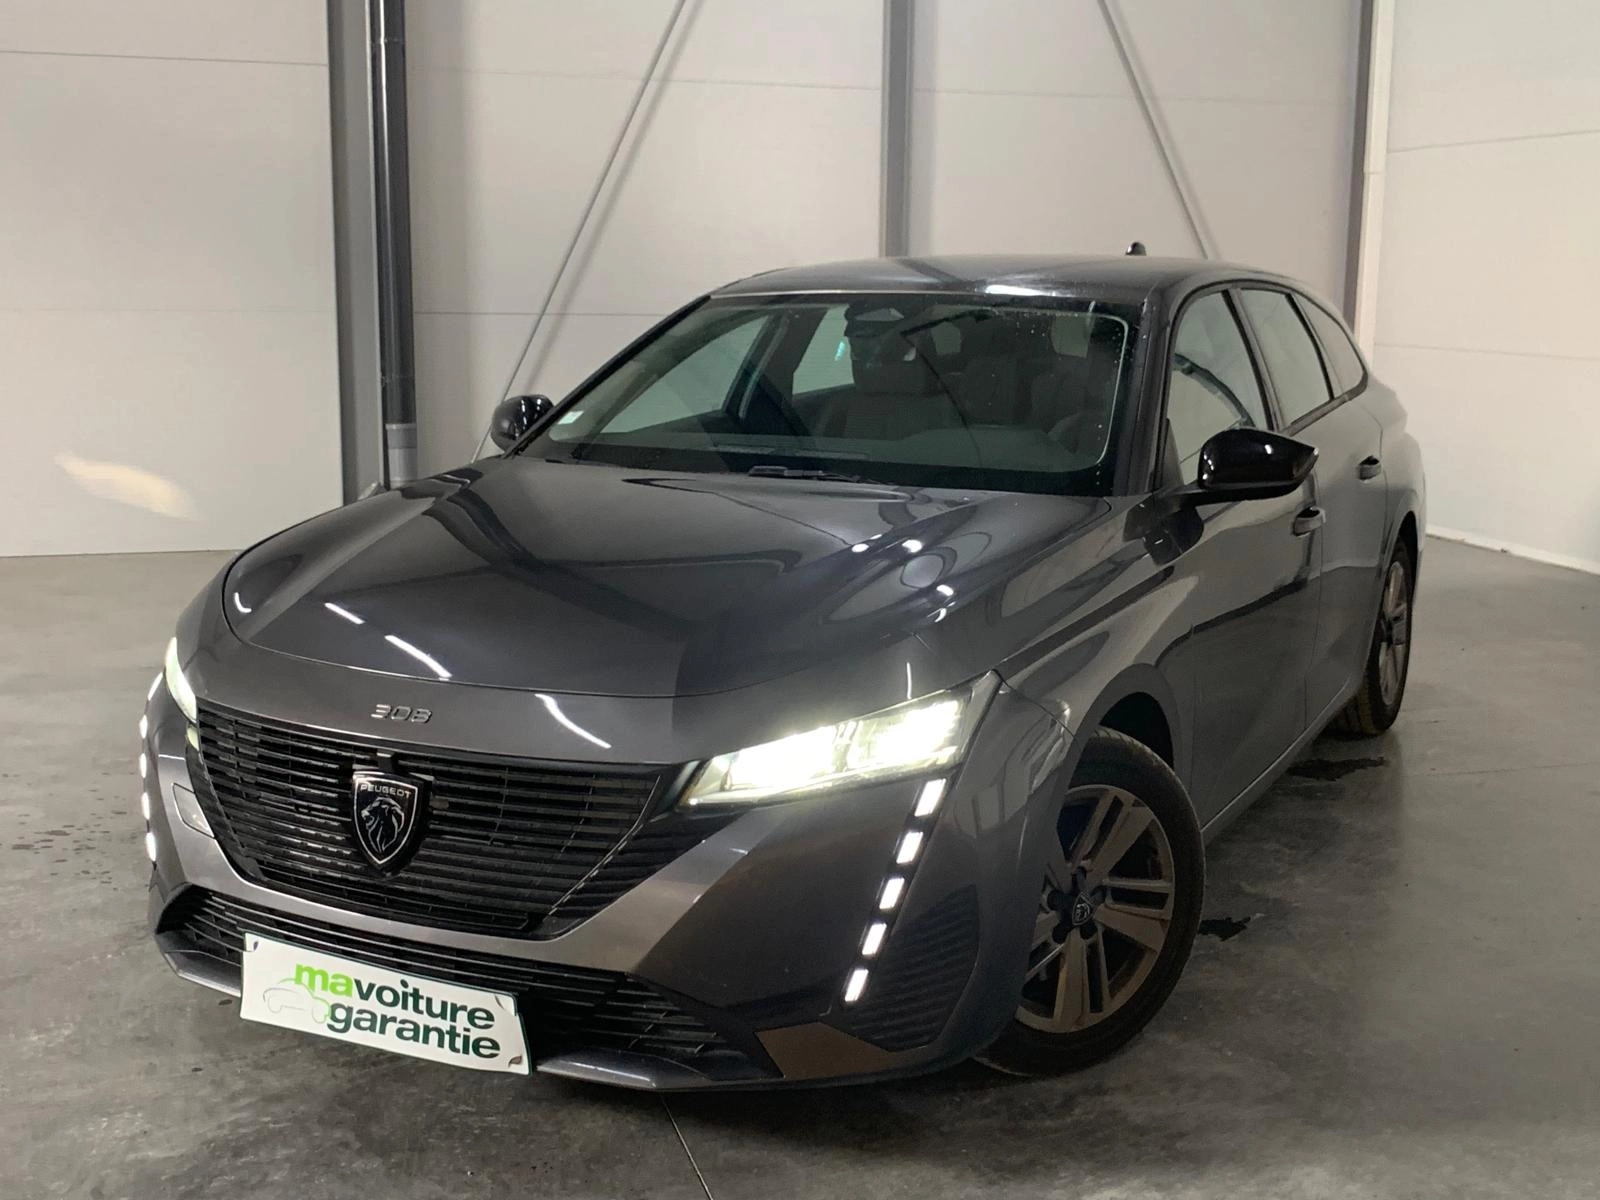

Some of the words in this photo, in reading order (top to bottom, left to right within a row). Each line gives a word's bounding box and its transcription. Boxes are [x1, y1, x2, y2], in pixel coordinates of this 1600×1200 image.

[371, 704, 433, 724] 308
[360, 783, 412, 799] PEUGEOT
[327, 1002, 501, 1059] garantie
